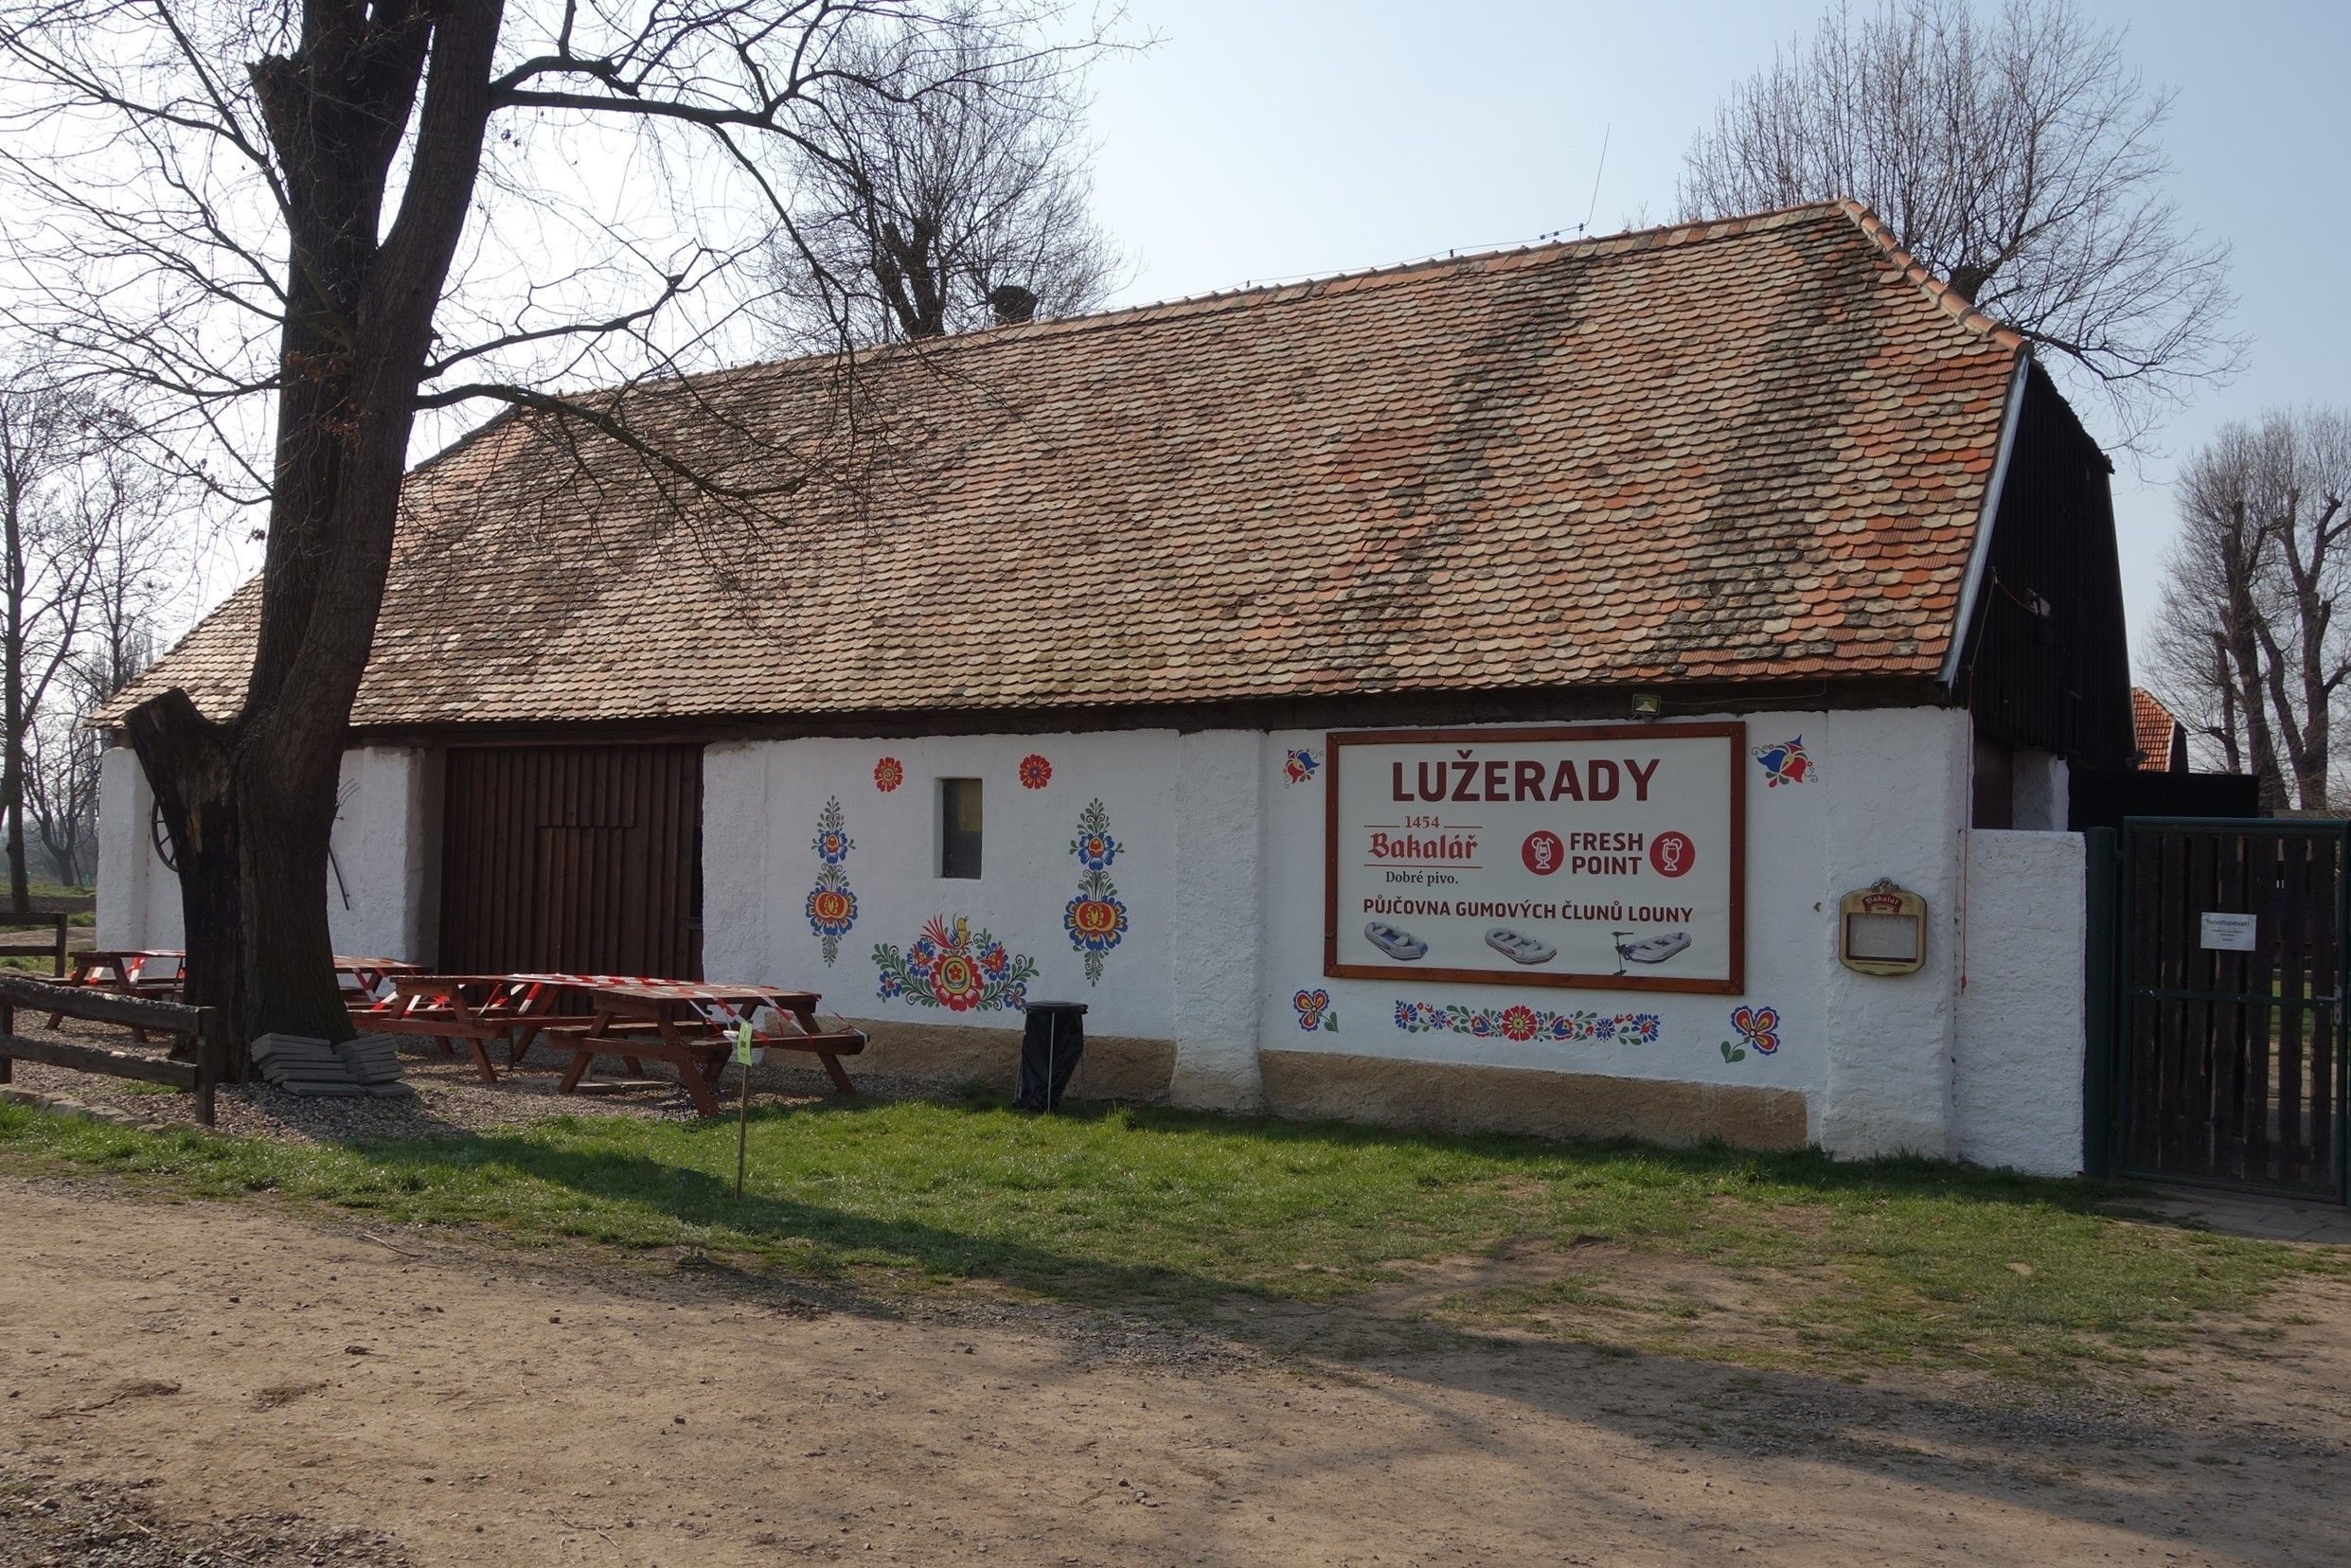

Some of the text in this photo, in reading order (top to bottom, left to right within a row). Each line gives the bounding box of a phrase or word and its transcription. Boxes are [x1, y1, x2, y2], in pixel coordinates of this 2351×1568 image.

[1392, 749, 1661, 802] LUŽERADY
[1404, 815, 1440, 829] 1454
[1367, 832, 1478, 860] Bakalář
[1570, 832, 1644, 851] FRESH
[1572, 856, 1643, 875] POINT
[1385, 870, 1459, 887] Dobré pivo.
[1363, 894, 1693, 923] PŮJČOVNA GUMOVÝCH ČLUNŮ LOUNY
